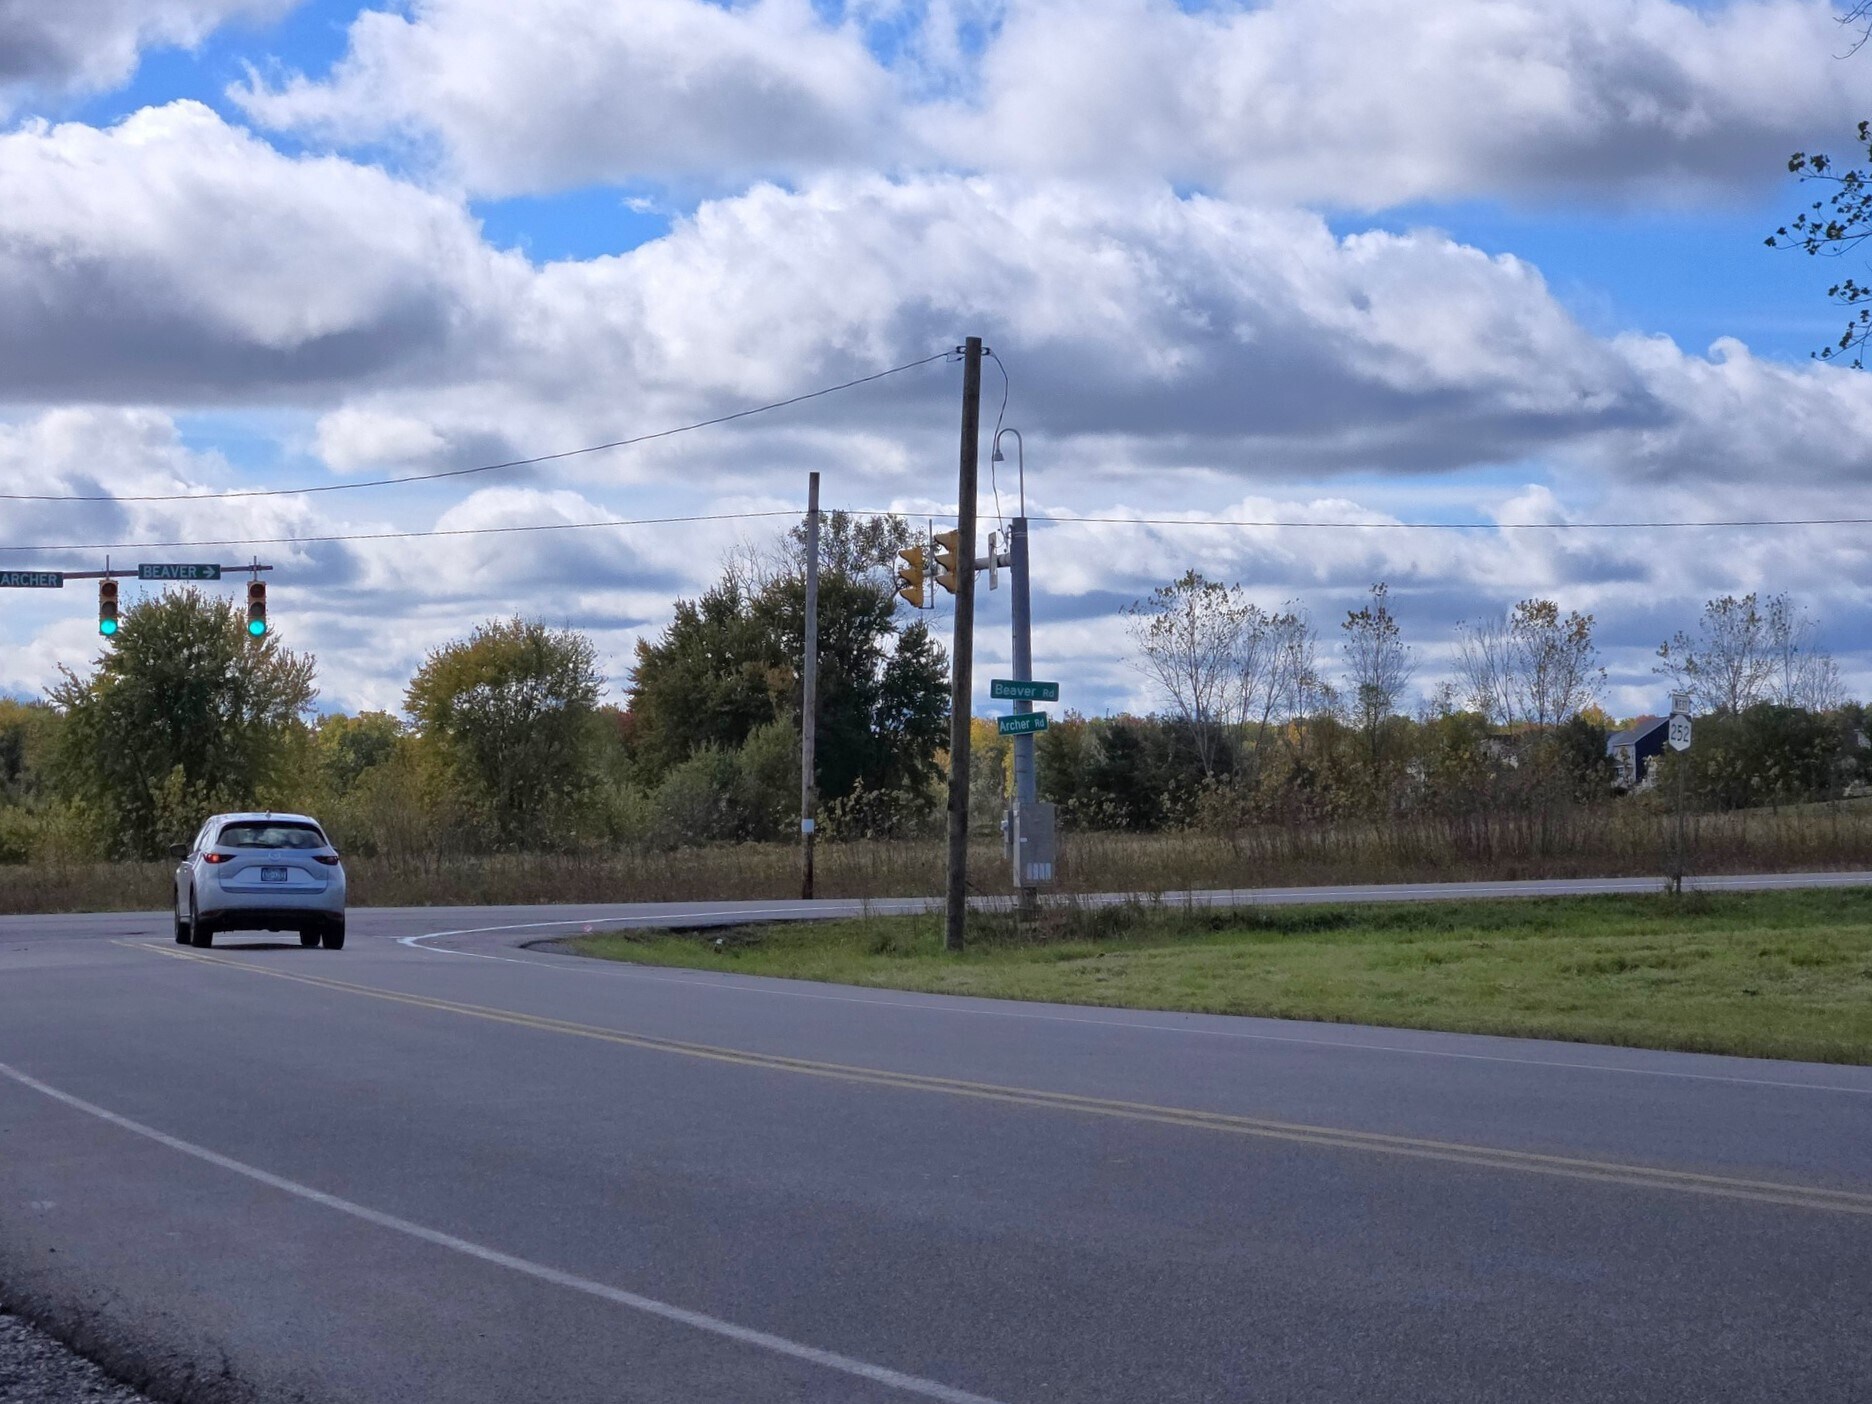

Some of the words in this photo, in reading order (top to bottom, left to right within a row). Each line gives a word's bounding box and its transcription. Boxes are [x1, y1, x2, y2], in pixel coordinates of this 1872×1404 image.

[143, 565, 197, 578] BEAVER
[0, 573, 57, 586] ARCHER
[995, 684, 1036, 697] Beaver
[1042, 688, 1055, 697] Rd
[1000, 719, 1030, 731] Archer
[1034, 718, 1045, 728] Rd
[1671, 723, 1689, 742] 252
